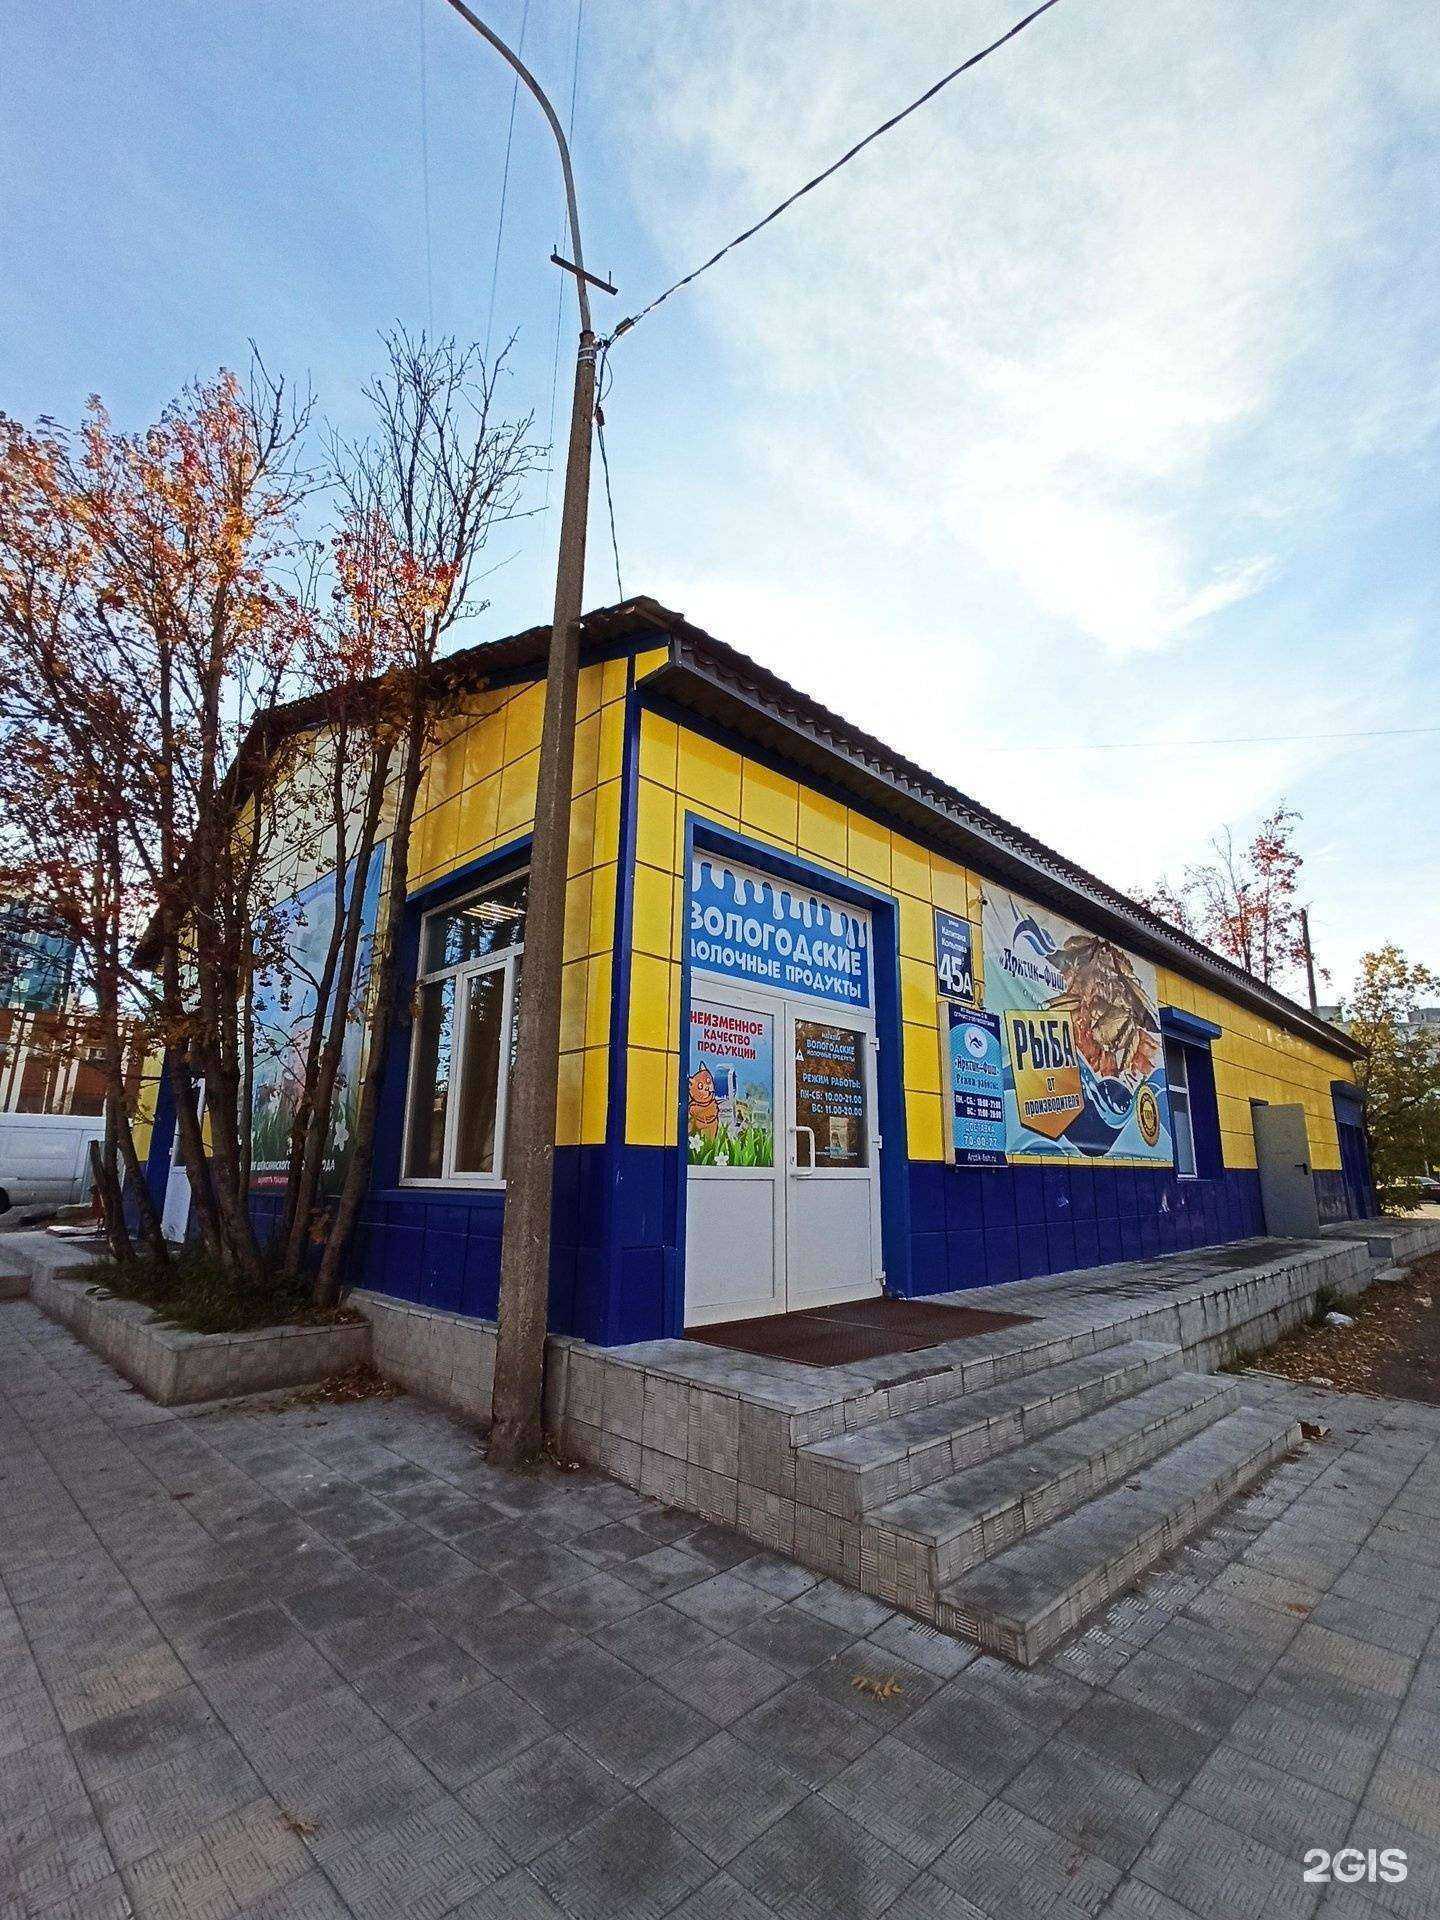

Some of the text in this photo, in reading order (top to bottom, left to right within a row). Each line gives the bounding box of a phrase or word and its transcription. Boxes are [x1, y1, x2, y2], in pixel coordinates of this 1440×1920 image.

[690, 938, 862, 999] ОЛОЧНЫЕ ПРОДУКТЫ
[690, 1010, 763, 1036] НЕИЗМЕННОЕ
[703, 1028, 751, 1047] КАЧЕСТВО
[1012, 1018, 1078, 1071] РЫБА
[697, 1041, 757, 1060] ПРОДУКЦИИ
[803, 1072, 829, 1086] РЕЖИМ
[1024, 1094, 1081, 1118] производителя
